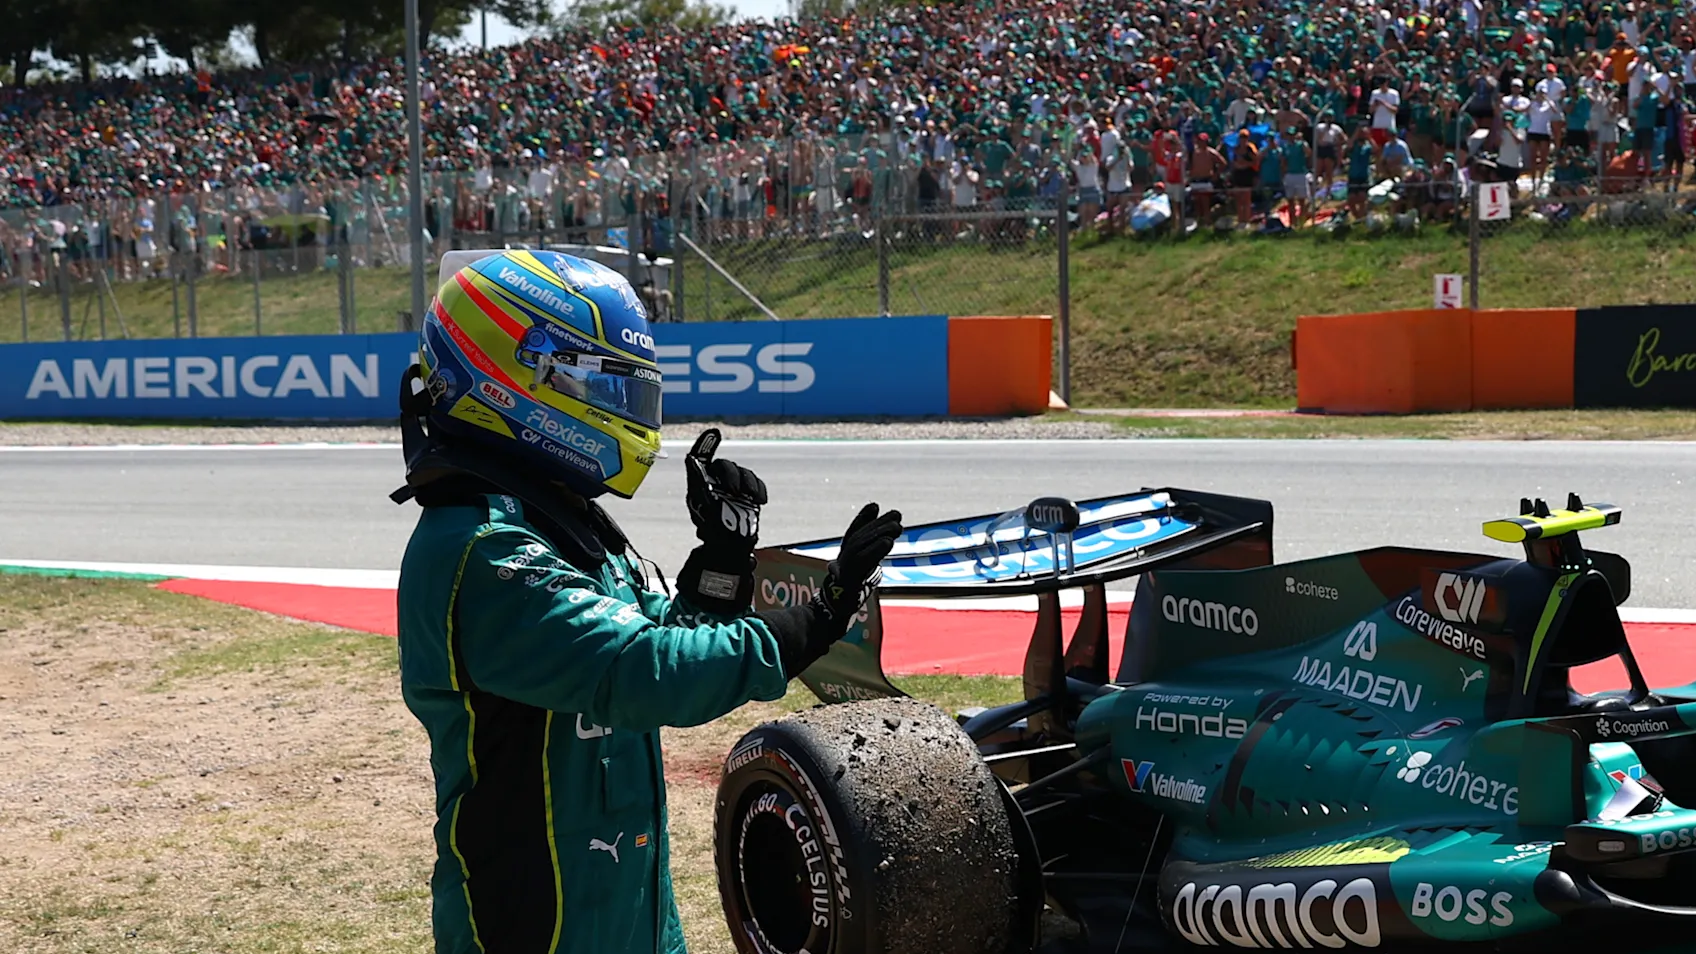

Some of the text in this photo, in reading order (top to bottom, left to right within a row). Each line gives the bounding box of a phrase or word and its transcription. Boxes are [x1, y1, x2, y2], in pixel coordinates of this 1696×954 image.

[498, 267, 575, 315] Valvoline
[544, 321, 595, 352] finetwork
[26, 353, 380, 400] AMERICAN
[482, 383, 512, 405] BELL
[525, 408, 606, 456] Flexicar
[541, 438, 598, 473] CoreWeave
[1031, 502, 1064, 524] arm
[1296, 580, 1338, 601] cohere
[1162, 594, 1259, 636] aramco
[1143, 692, 1234, 710] Powered by
[1293, 656, 1422, 712] MAADEN
[1135, 706, 1248, 739] Honda
[1612, 717, 1669, 736] Cognition
[726, 736, 765, 774] PIRELLI
[1150, 770, 1206, 804] Valvoline
[1421, 760, 1519, 816] cohere
[795, 824, 829, 928] CELSIUS
[1173, 877, 1382, 949] aramco
[1411, 882, 1514, 927] BOSS
